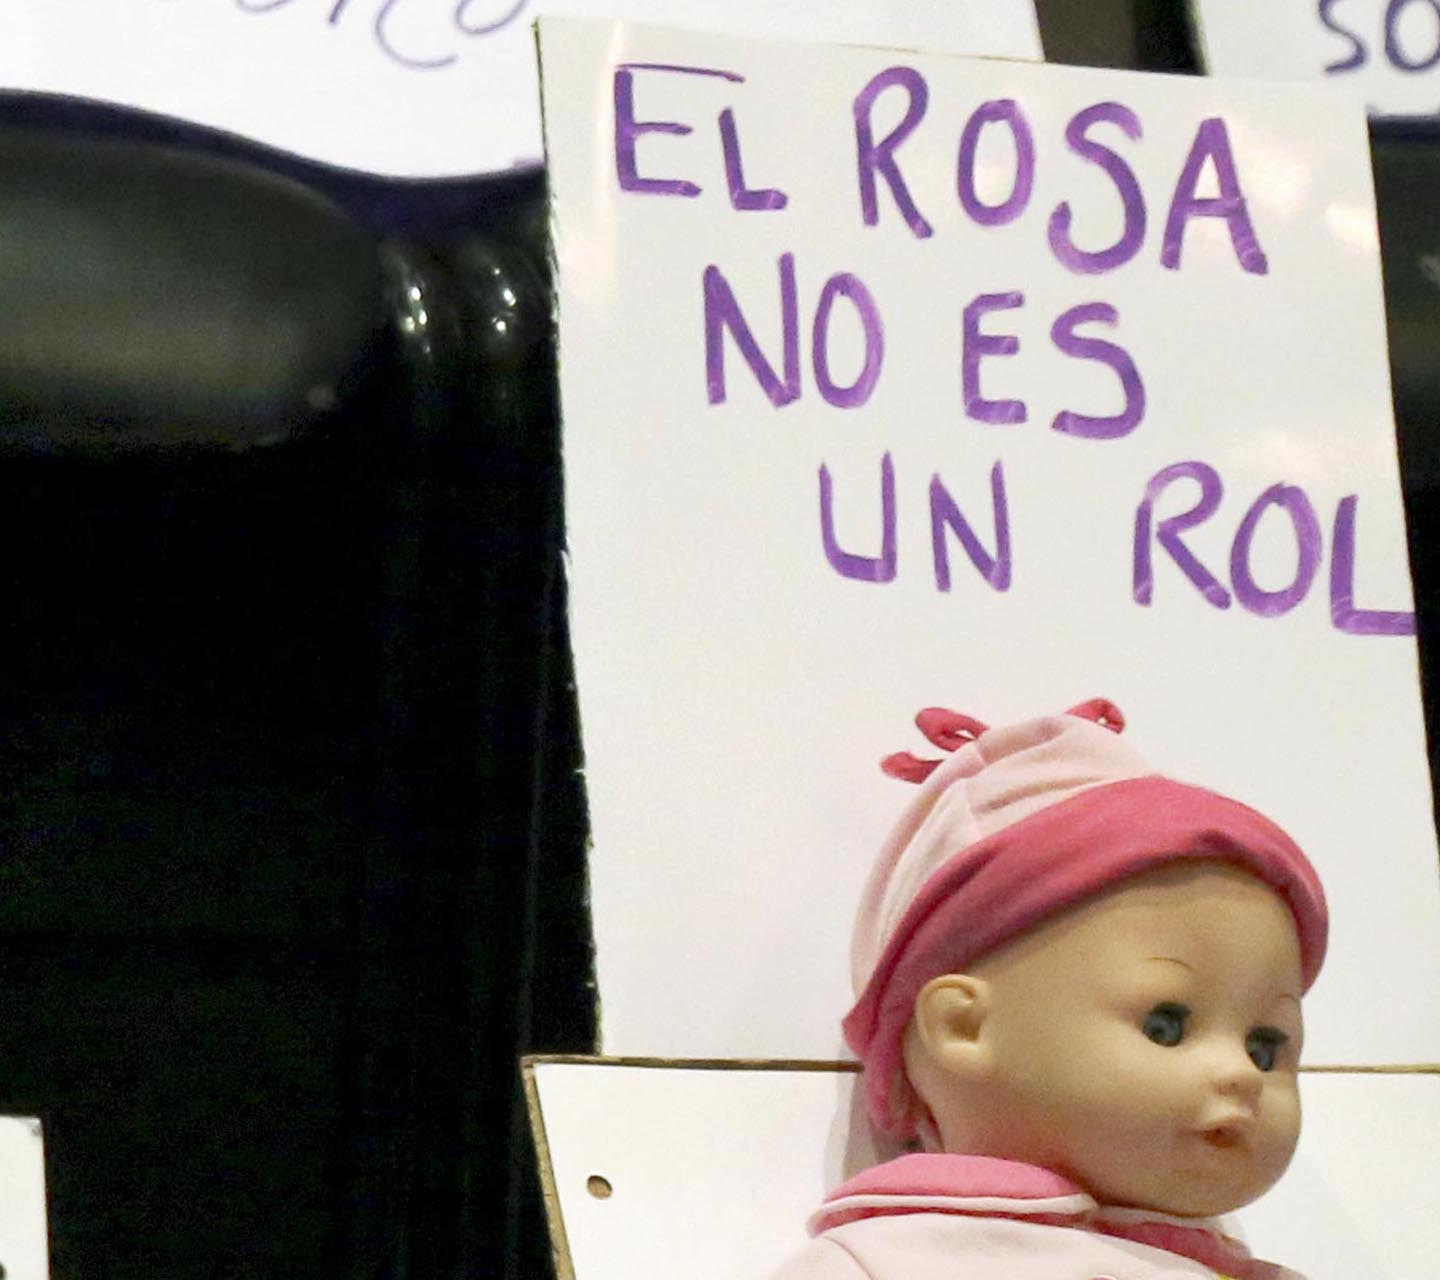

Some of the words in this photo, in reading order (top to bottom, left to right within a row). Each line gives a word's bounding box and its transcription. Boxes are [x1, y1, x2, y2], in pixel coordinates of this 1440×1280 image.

[614, 63, 790, 212] EL
[852, 65, 1269, 276] ROSA
[702, 251, 885, 410] NO
[961, 290, 1148, 440] ES
[818, 450, 1013, 594] UN
[1133, 460, 1417, 638] ROL
